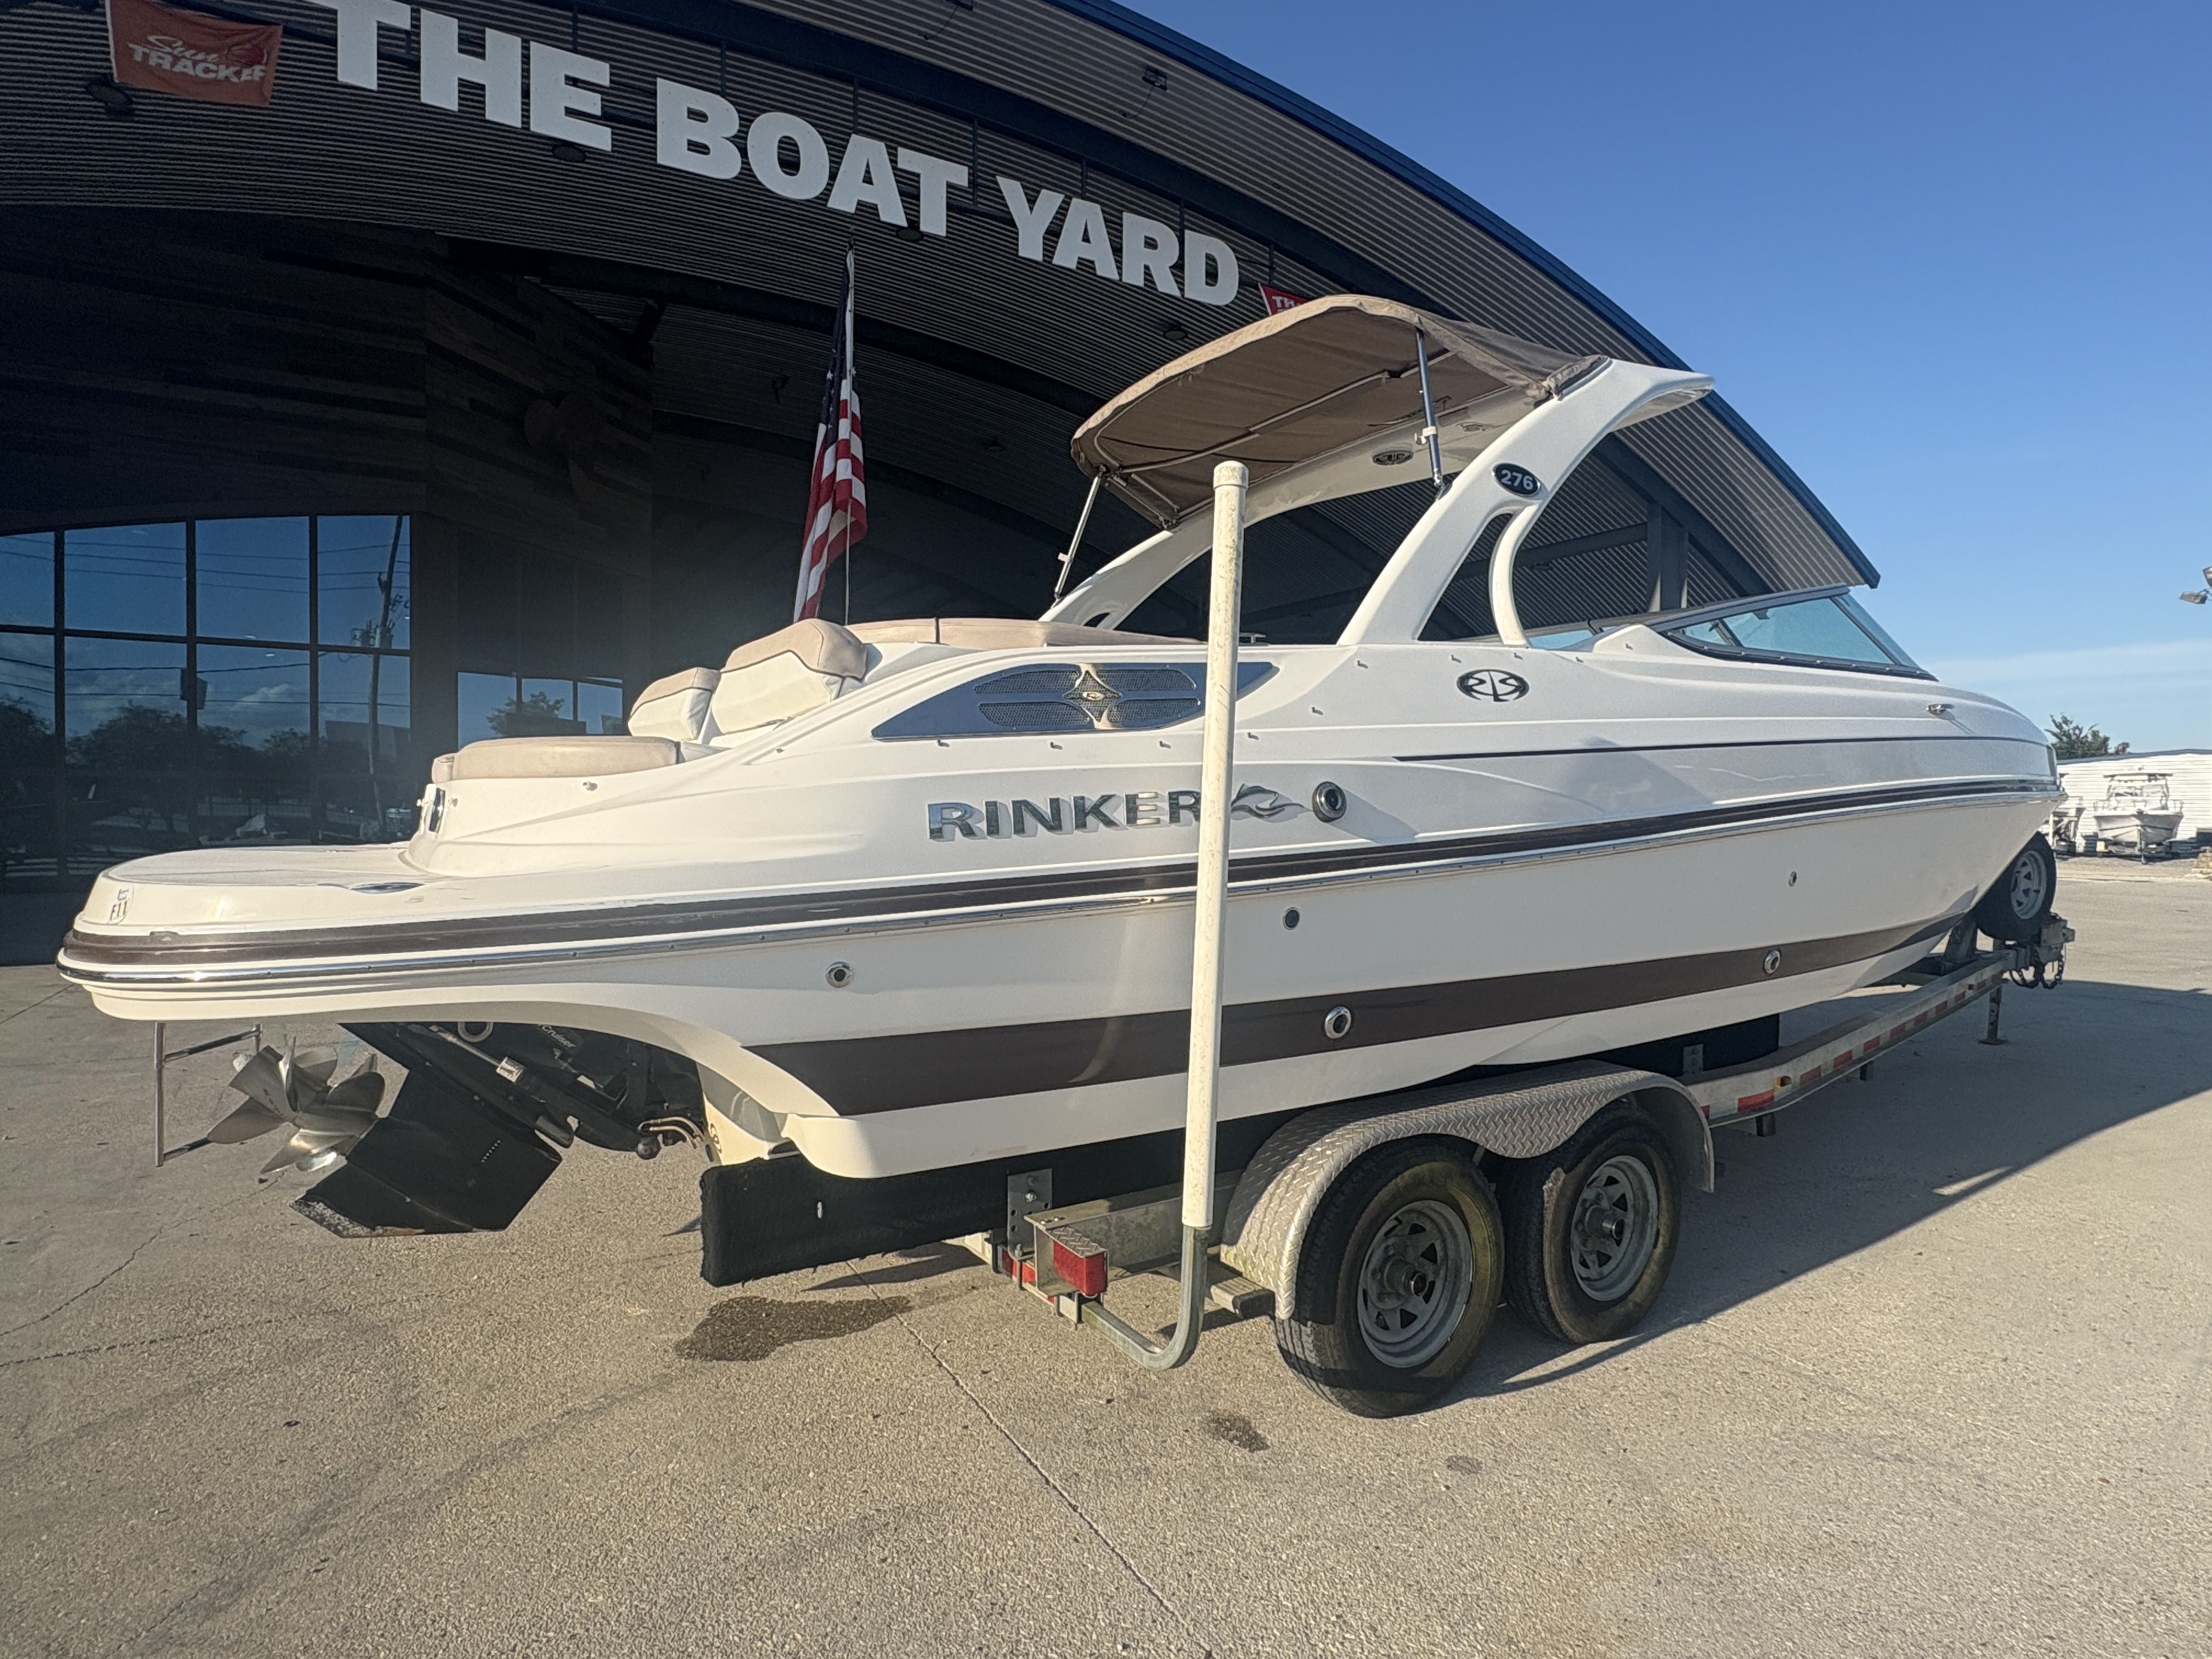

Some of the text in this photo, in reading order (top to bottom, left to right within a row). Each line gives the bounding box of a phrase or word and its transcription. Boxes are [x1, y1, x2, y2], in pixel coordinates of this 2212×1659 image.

[301, 0, 1239, 306] THE BOAT YARD
[1500, 470, 1534, 490] 276
[927, 790, 1200, 840] RINKER
